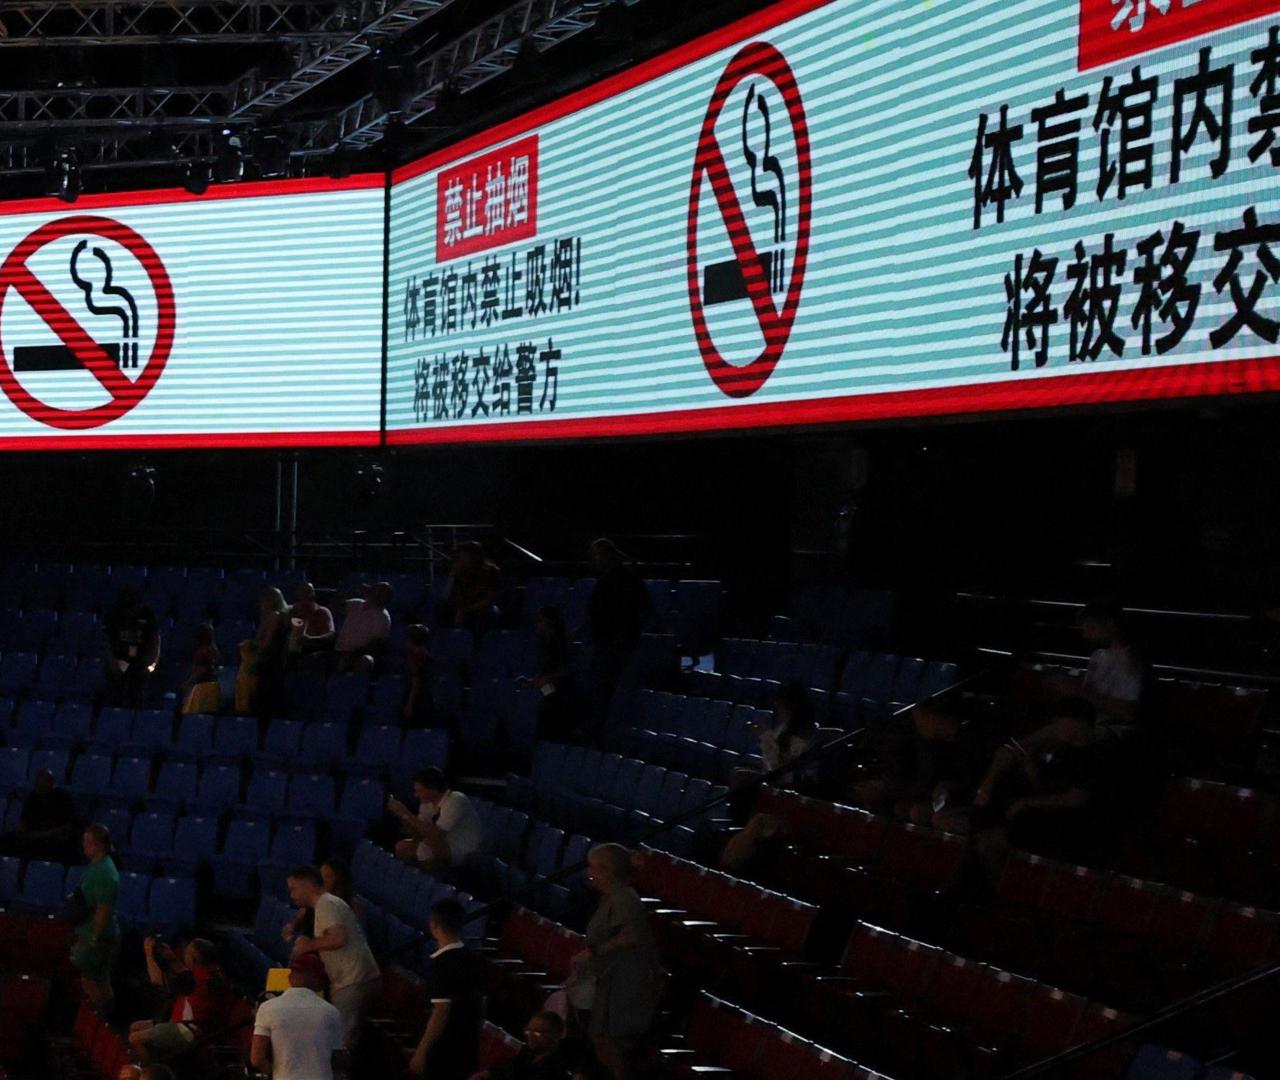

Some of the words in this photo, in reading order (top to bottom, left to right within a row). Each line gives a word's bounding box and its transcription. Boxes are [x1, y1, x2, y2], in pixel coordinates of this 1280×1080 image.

[444, 156, 529, 246] 禁止抽烟
[413, 337, 562, 423] 将被移交给警方
